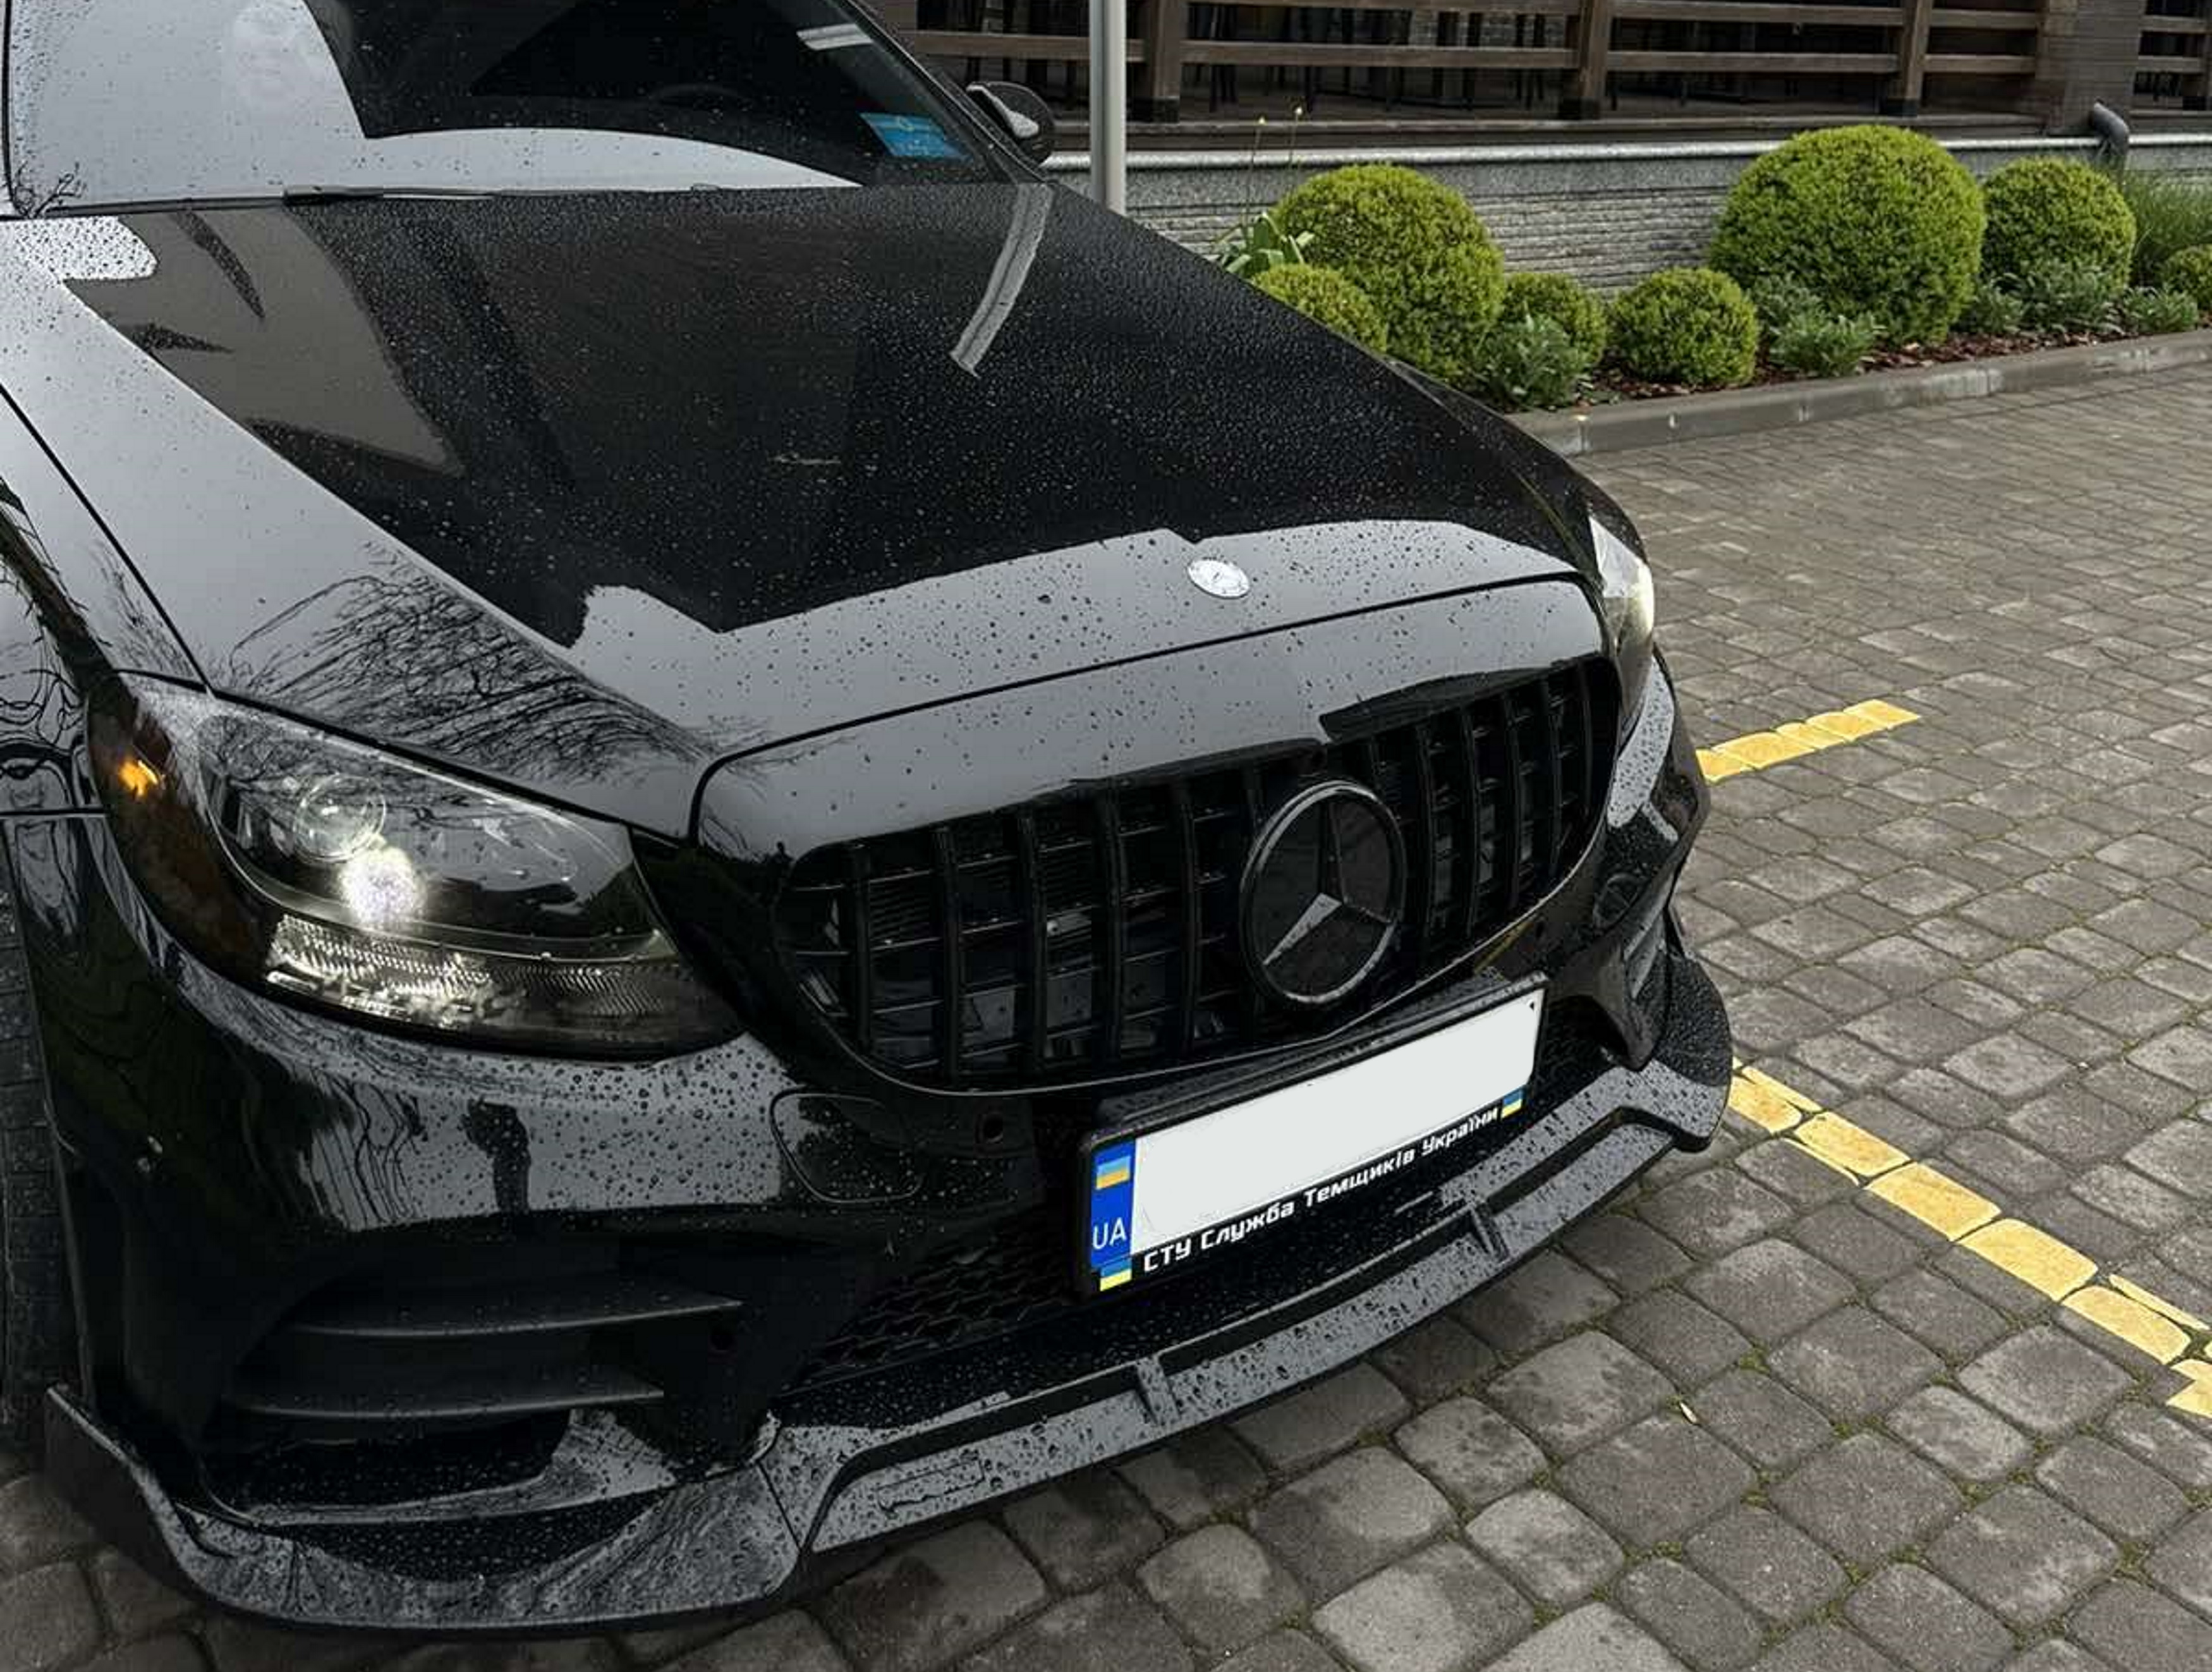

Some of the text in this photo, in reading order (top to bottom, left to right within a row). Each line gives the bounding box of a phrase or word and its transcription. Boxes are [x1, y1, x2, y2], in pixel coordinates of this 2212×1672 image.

[1092, 1217, 1127, 1250] UA
[1144, 1107, 1498, 1272] СТУ Служба Темщиків України
